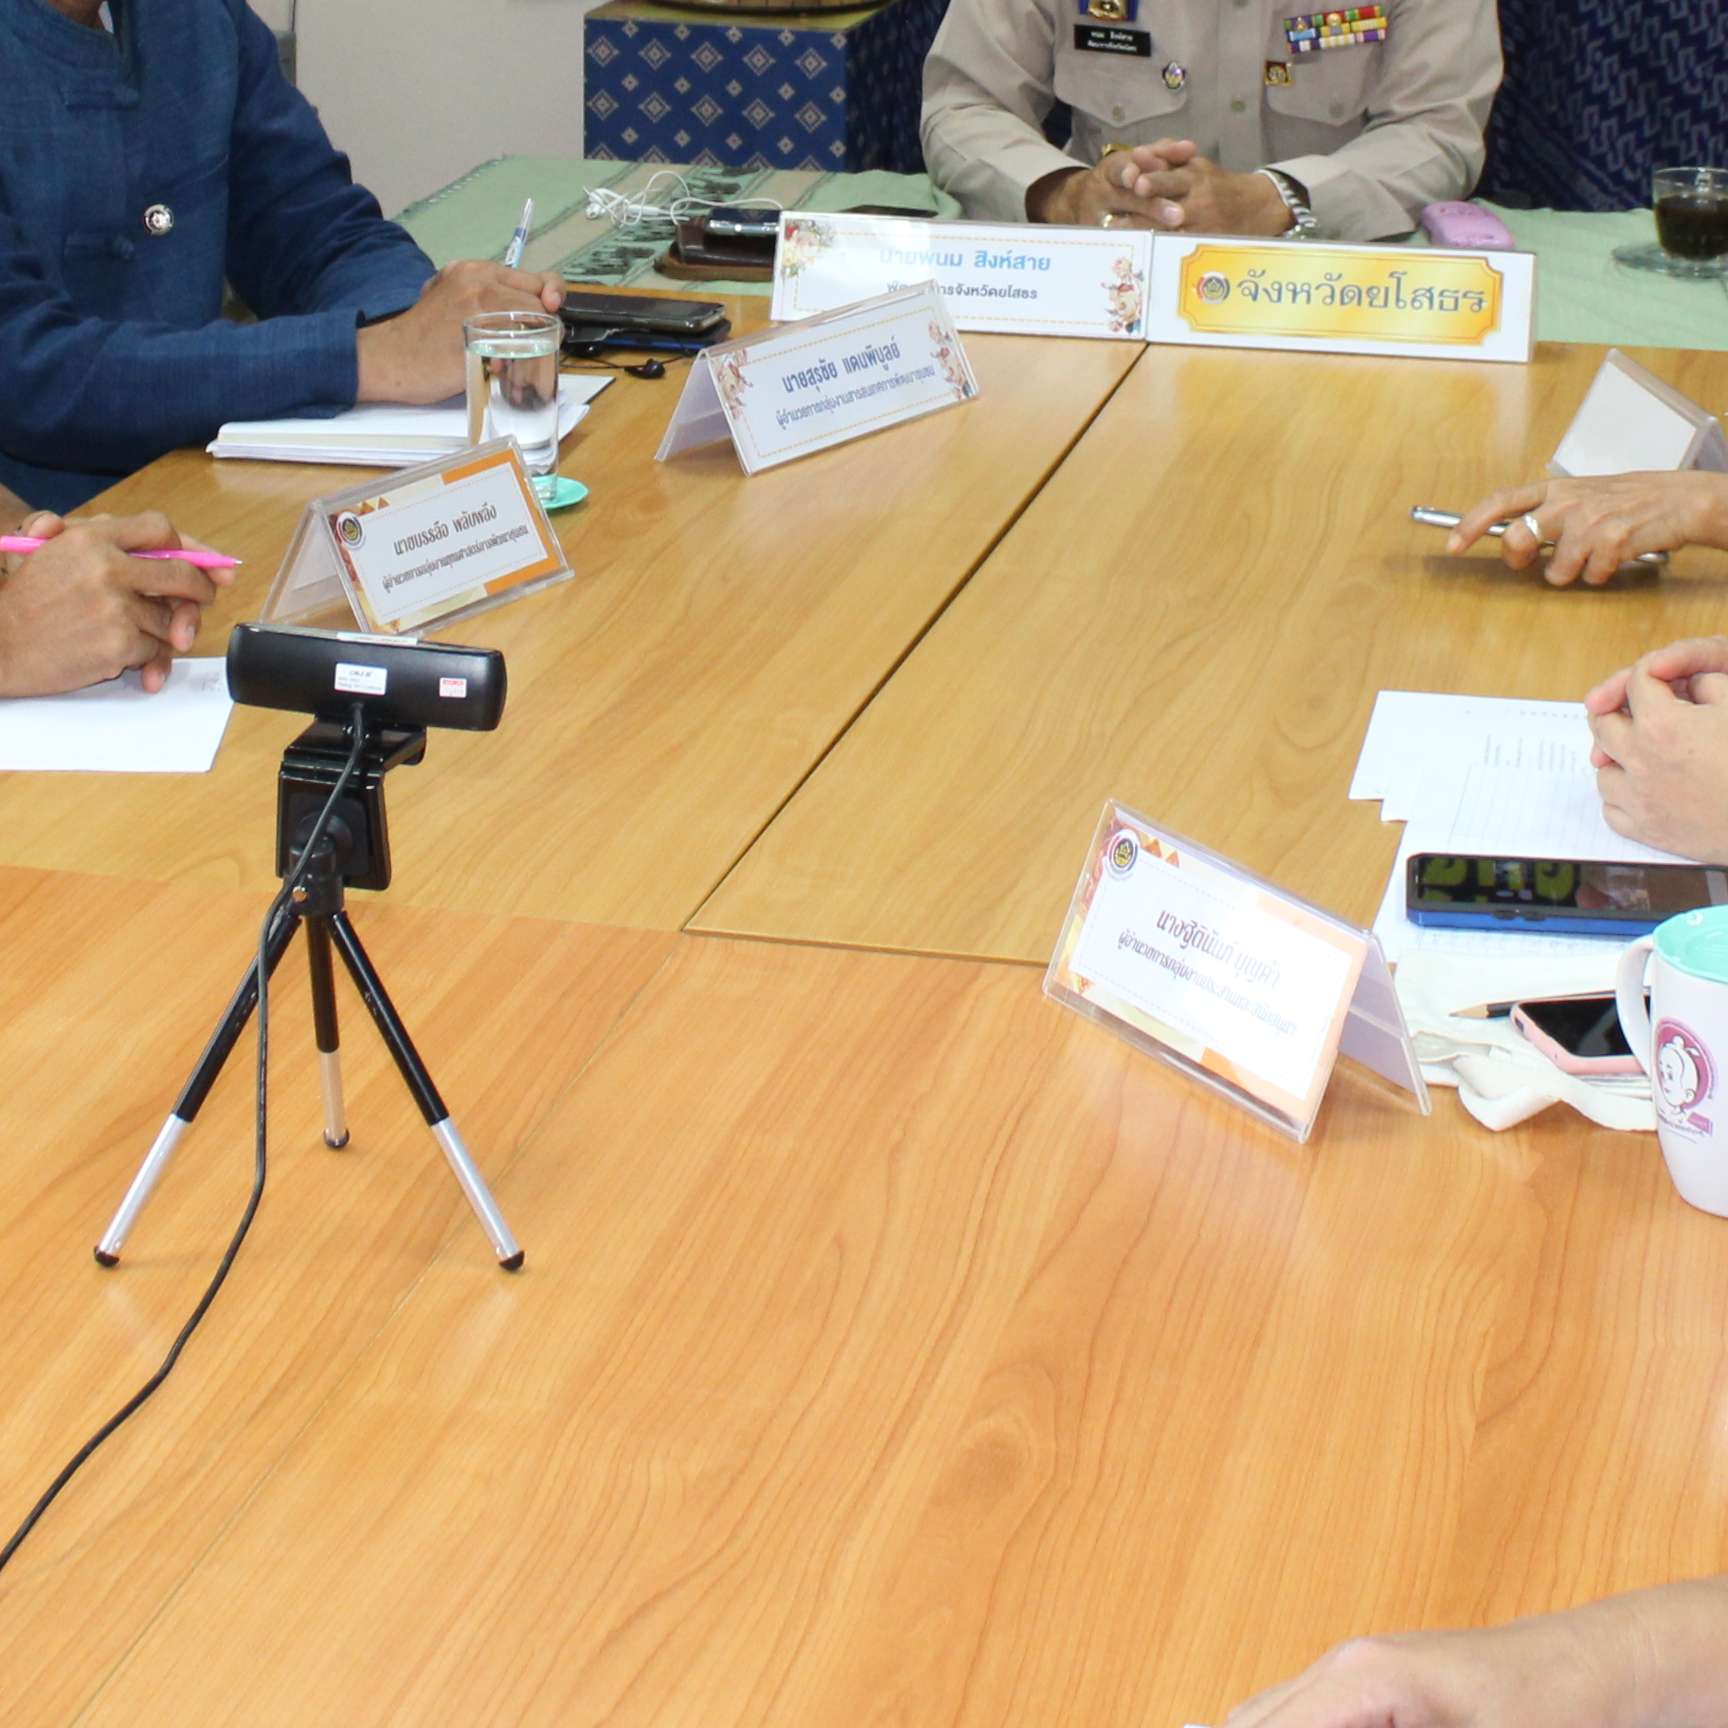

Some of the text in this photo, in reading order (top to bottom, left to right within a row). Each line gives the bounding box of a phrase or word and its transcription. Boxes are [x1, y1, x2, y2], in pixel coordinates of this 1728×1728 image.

[974, 248, 1051, 271] สิงห์สาย
[1237, 269, 1486, 313] จังหวัดยโสธร
[781, 358, 839, 393] นายสุรชัย
[393, 520, 449, 556] นายบรรลือ
